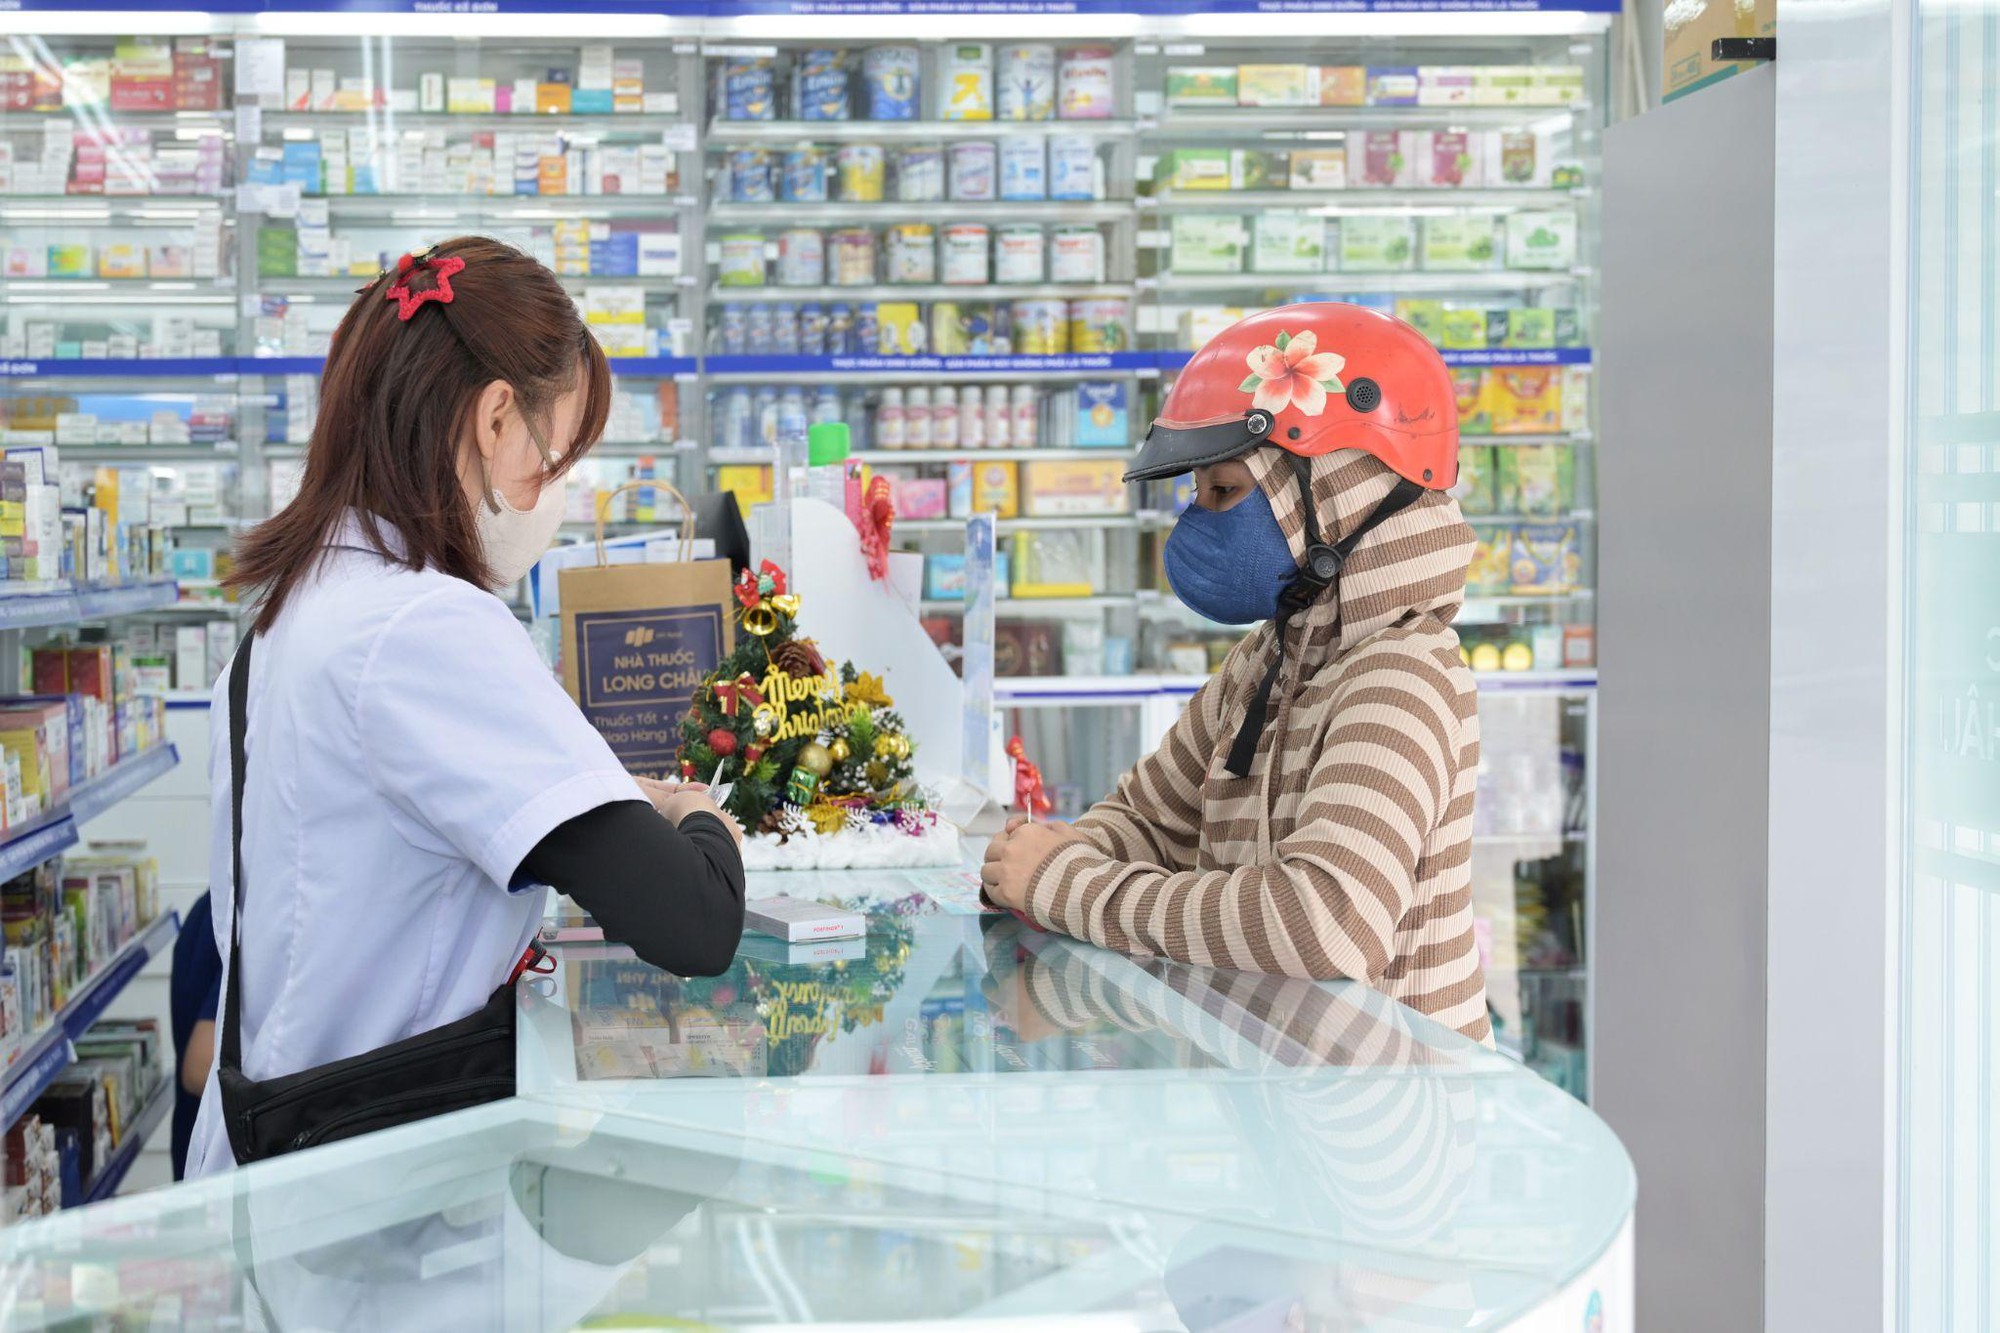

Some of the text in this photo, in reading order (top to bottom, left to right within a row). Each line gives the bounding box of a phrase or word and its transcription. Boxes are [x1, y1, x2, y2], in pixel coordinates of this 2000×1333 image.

[614, 647, 695, 669] NHÀ THUỐC
[602, 674, 655, 693] LONG
[759, 658, 844, 706] Merry
[594, 712, 634, 728] Thuốc
[637, 710, 658, 725] Tốt
[631, 728, 667, 744] Hàng
